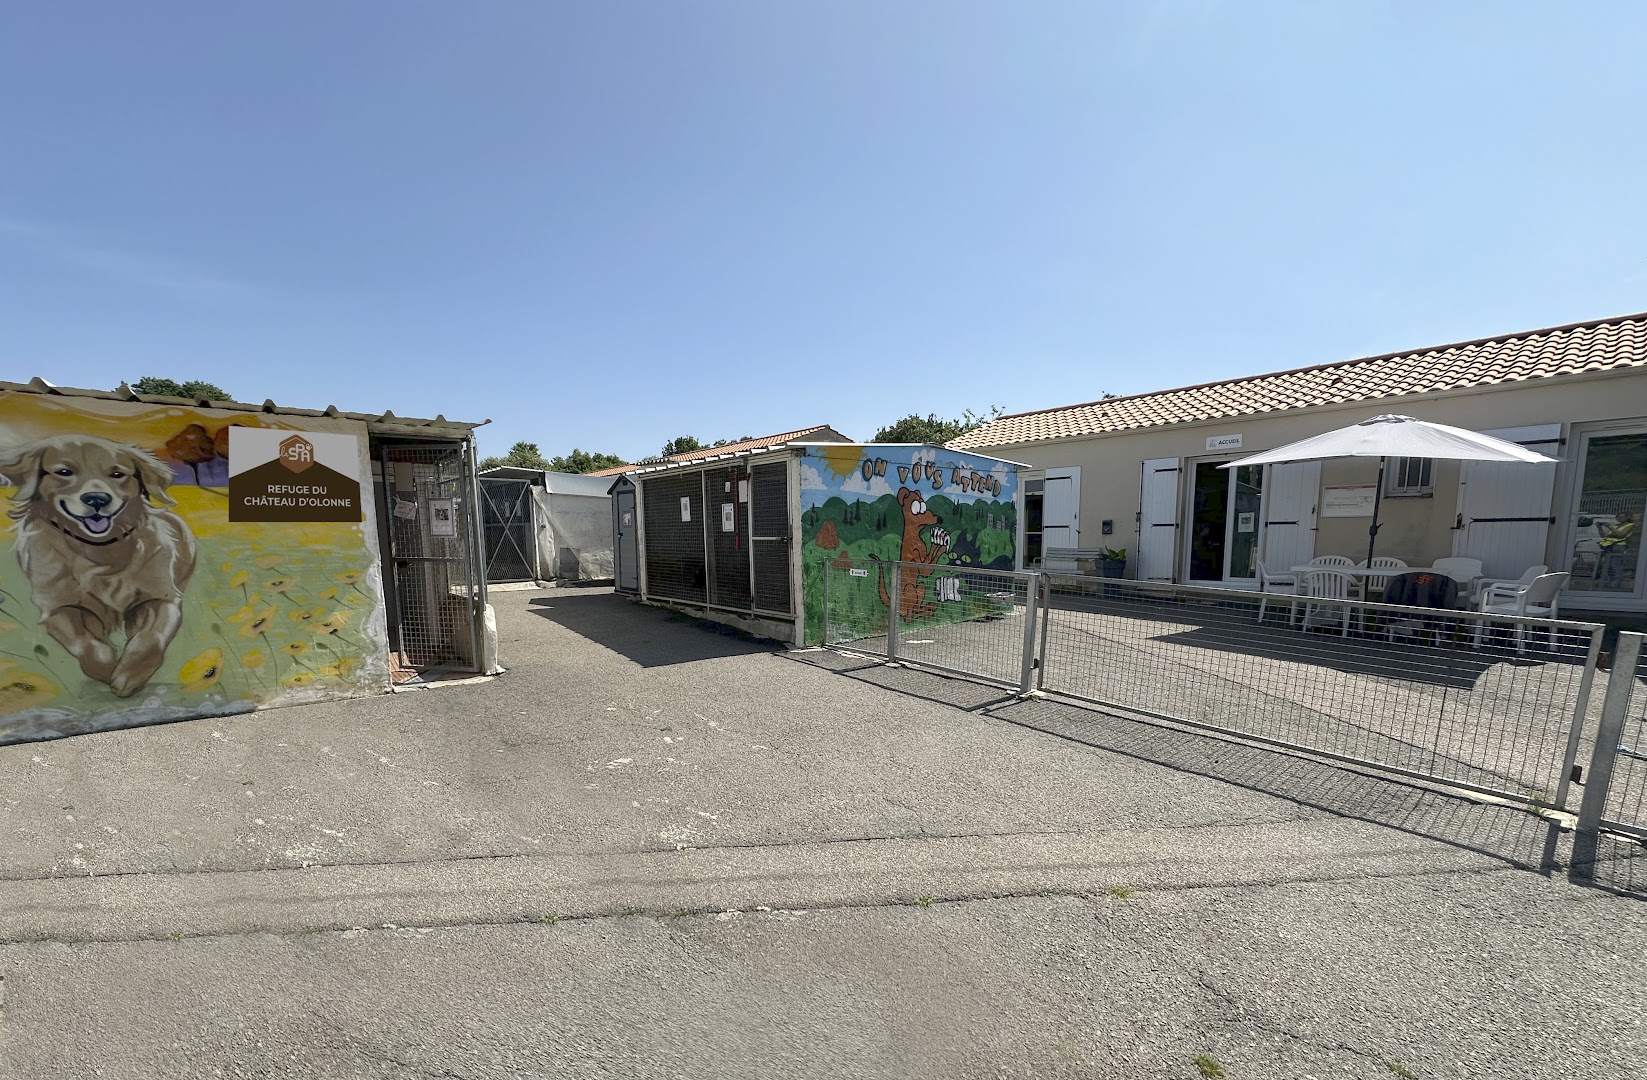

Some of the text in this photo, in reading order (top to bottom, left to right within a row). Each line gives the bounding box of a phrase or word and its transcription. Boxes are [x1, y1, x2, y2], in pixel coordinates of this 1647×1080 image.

[288, 443, 311, 463] SPA
[862, 457, 1002, 497] ON VOUS ATTEND
[267, 484, 328, 495] REFUGE DU
[243, 495, 352, 507] CHÂTEAU D'OLONNE
